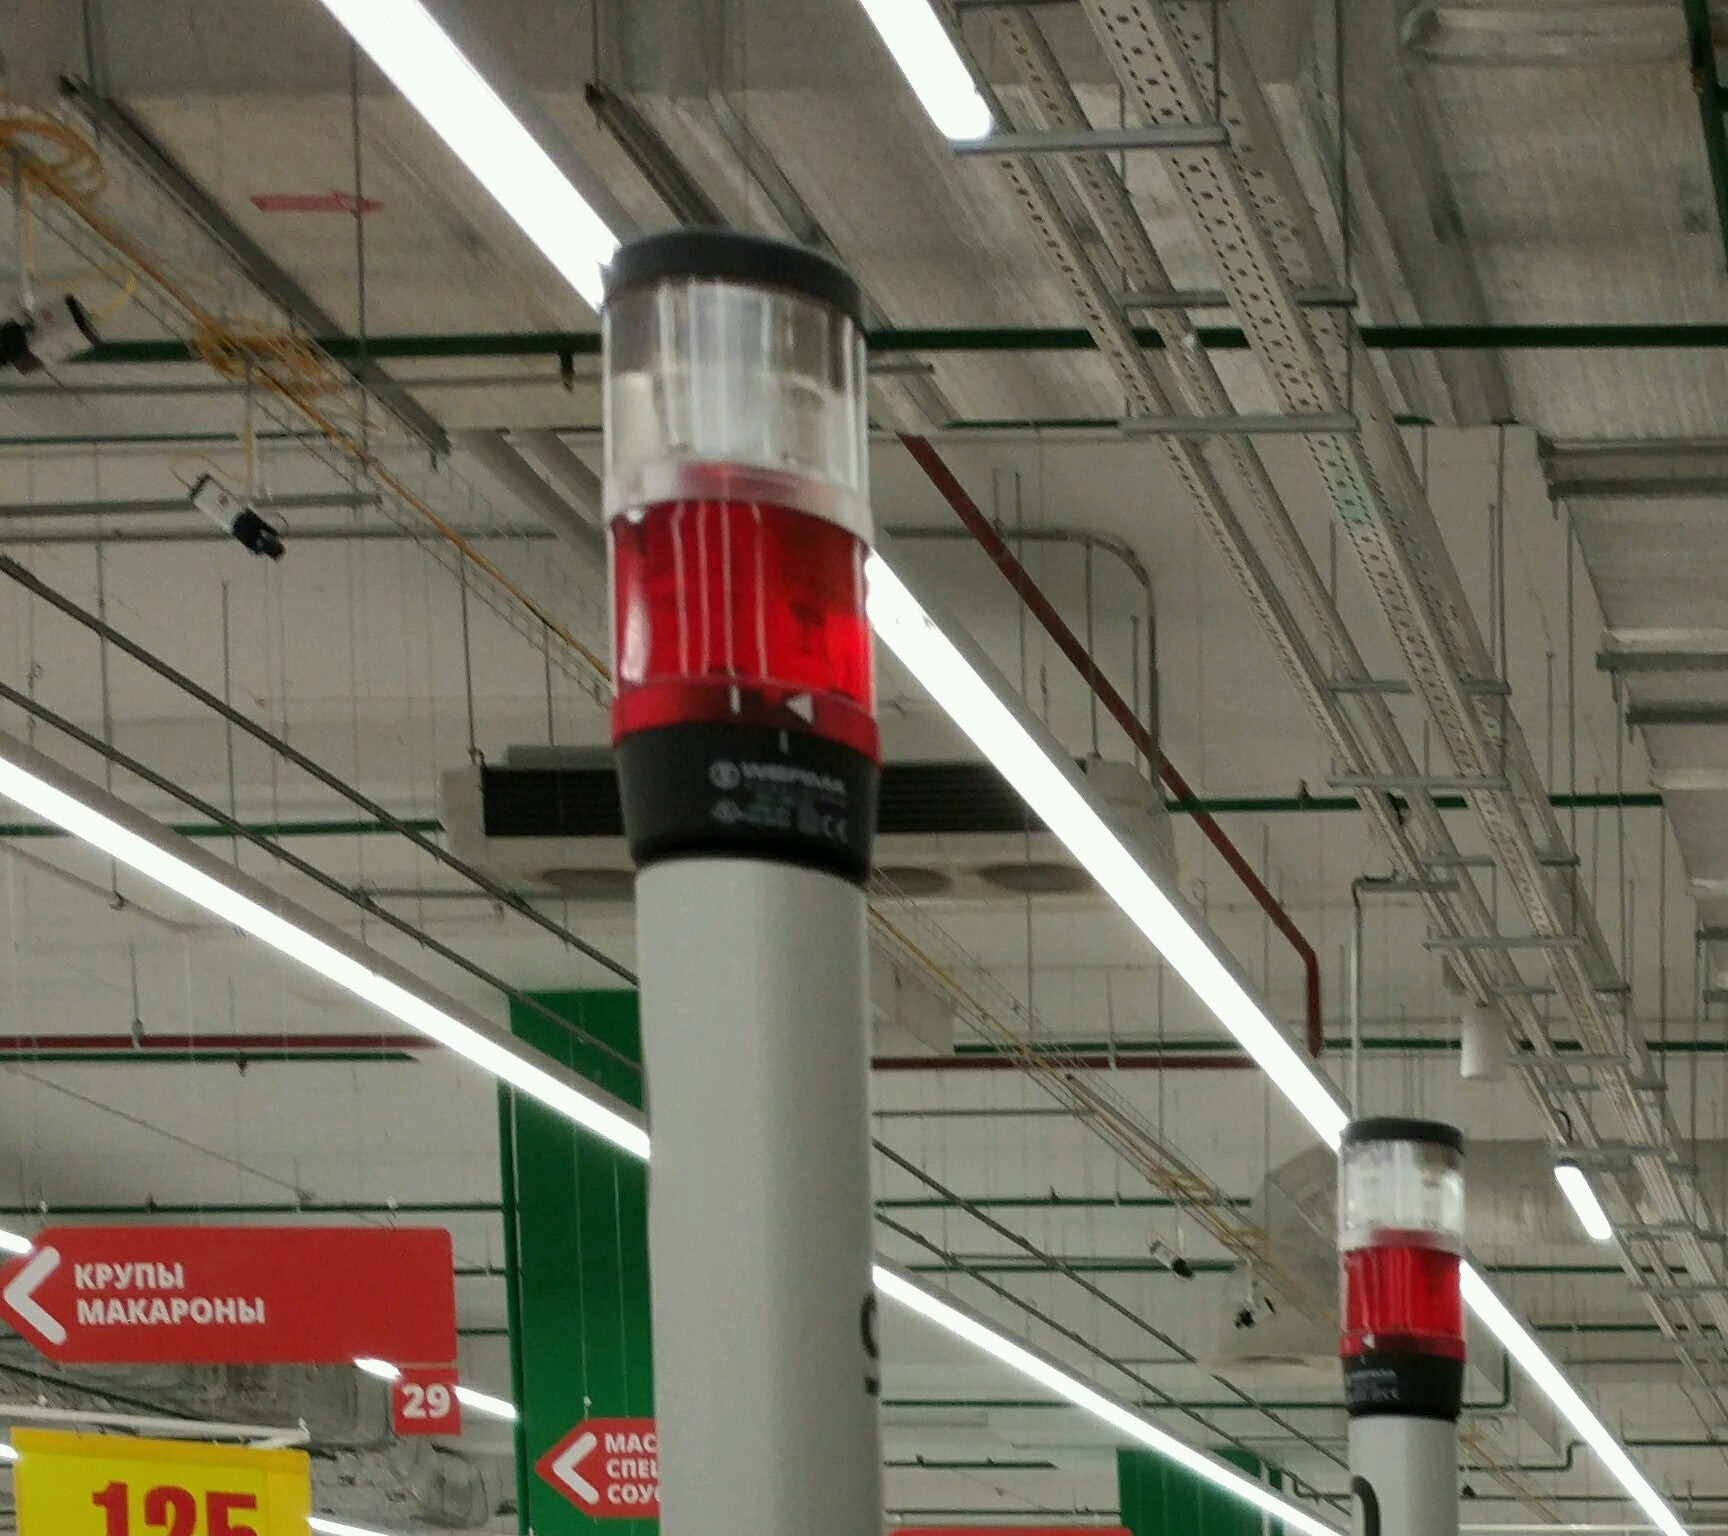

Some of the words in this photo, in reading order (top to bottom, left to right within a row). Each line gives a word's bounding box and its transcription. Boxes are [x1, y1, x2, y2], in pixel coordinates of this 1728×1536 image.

[74, 1263, 184, 1290] КРУПЫ
[77, 1297, 265, 1325] МАКАРОНЫ
[401, 1384, 452, 1418] 29
[607, 1483, 659, 1504] СОУ
